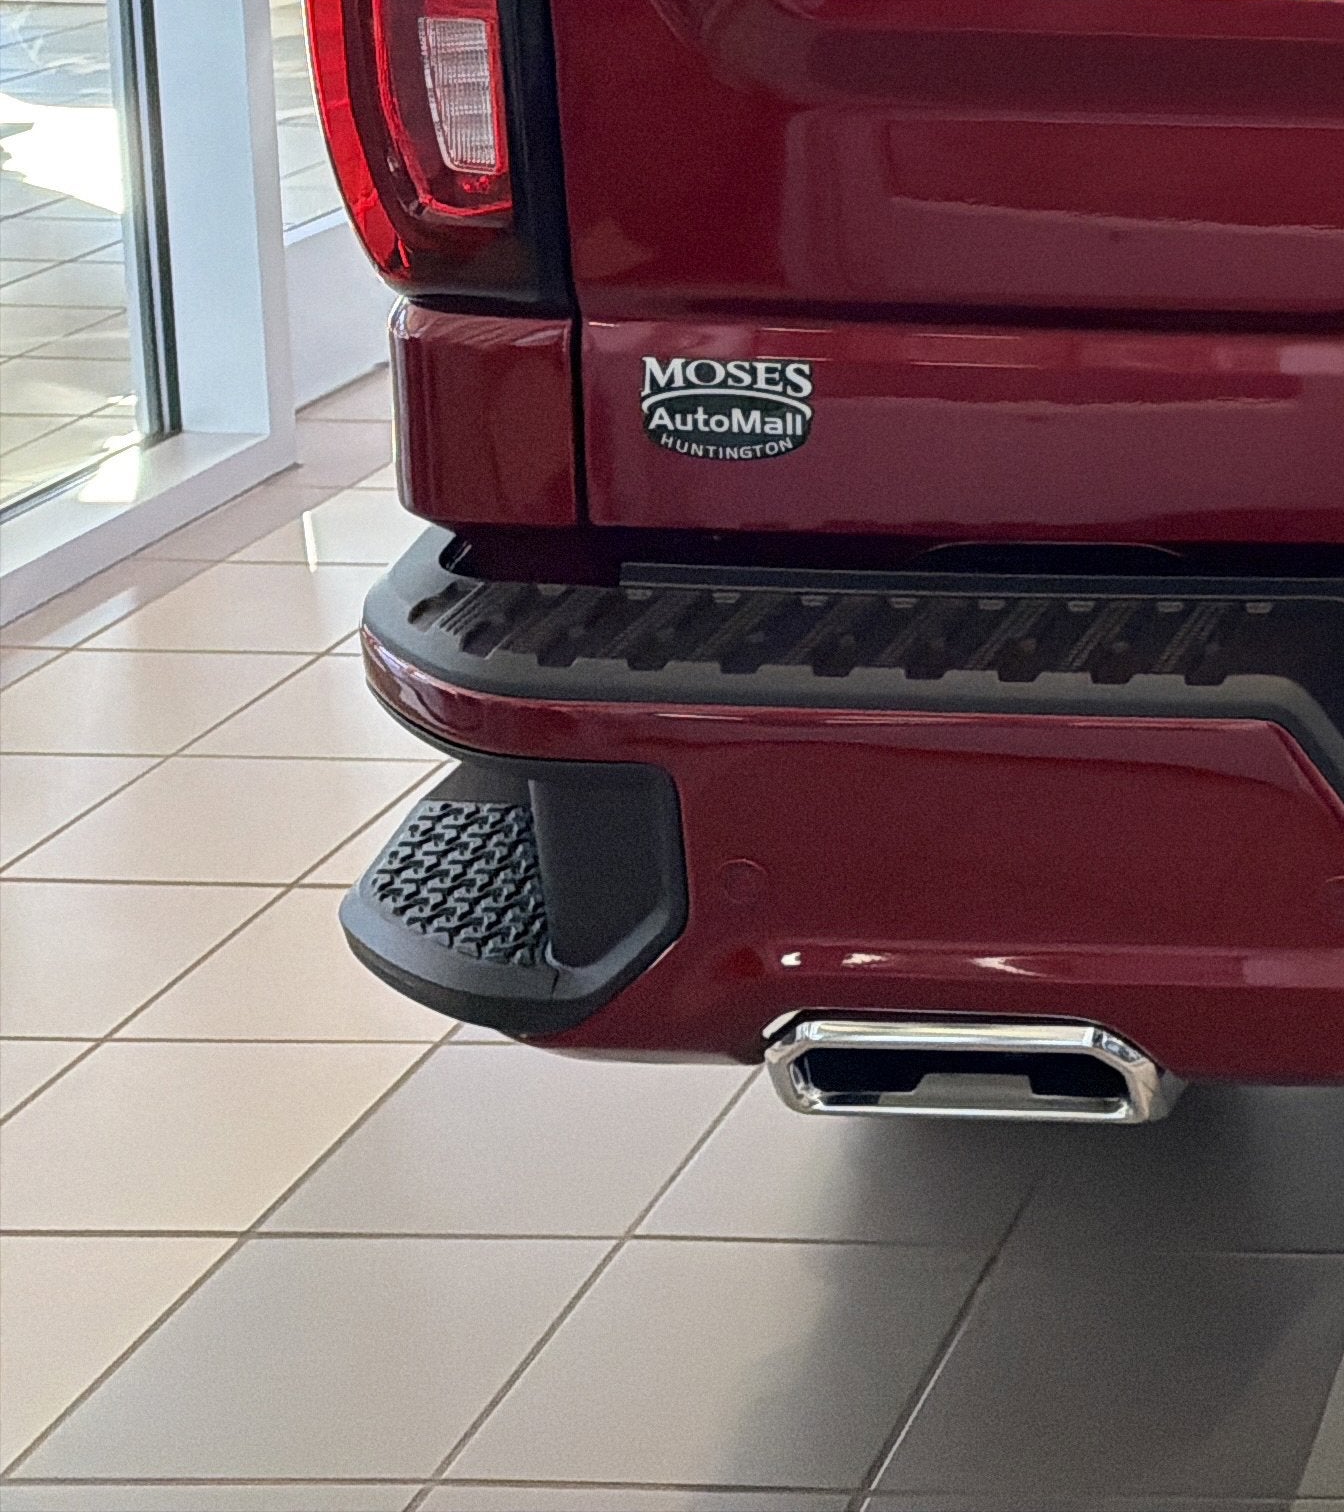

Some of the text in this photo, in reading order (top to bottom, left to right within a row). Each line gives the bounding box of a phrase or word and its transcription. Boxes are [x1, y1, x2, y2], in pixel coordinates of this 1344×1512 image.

[640, 356, 813, 397] MOSES
[648, 406, 803, 436] AutoMall
[660, 433, 793, 460] HUNTINGTON
